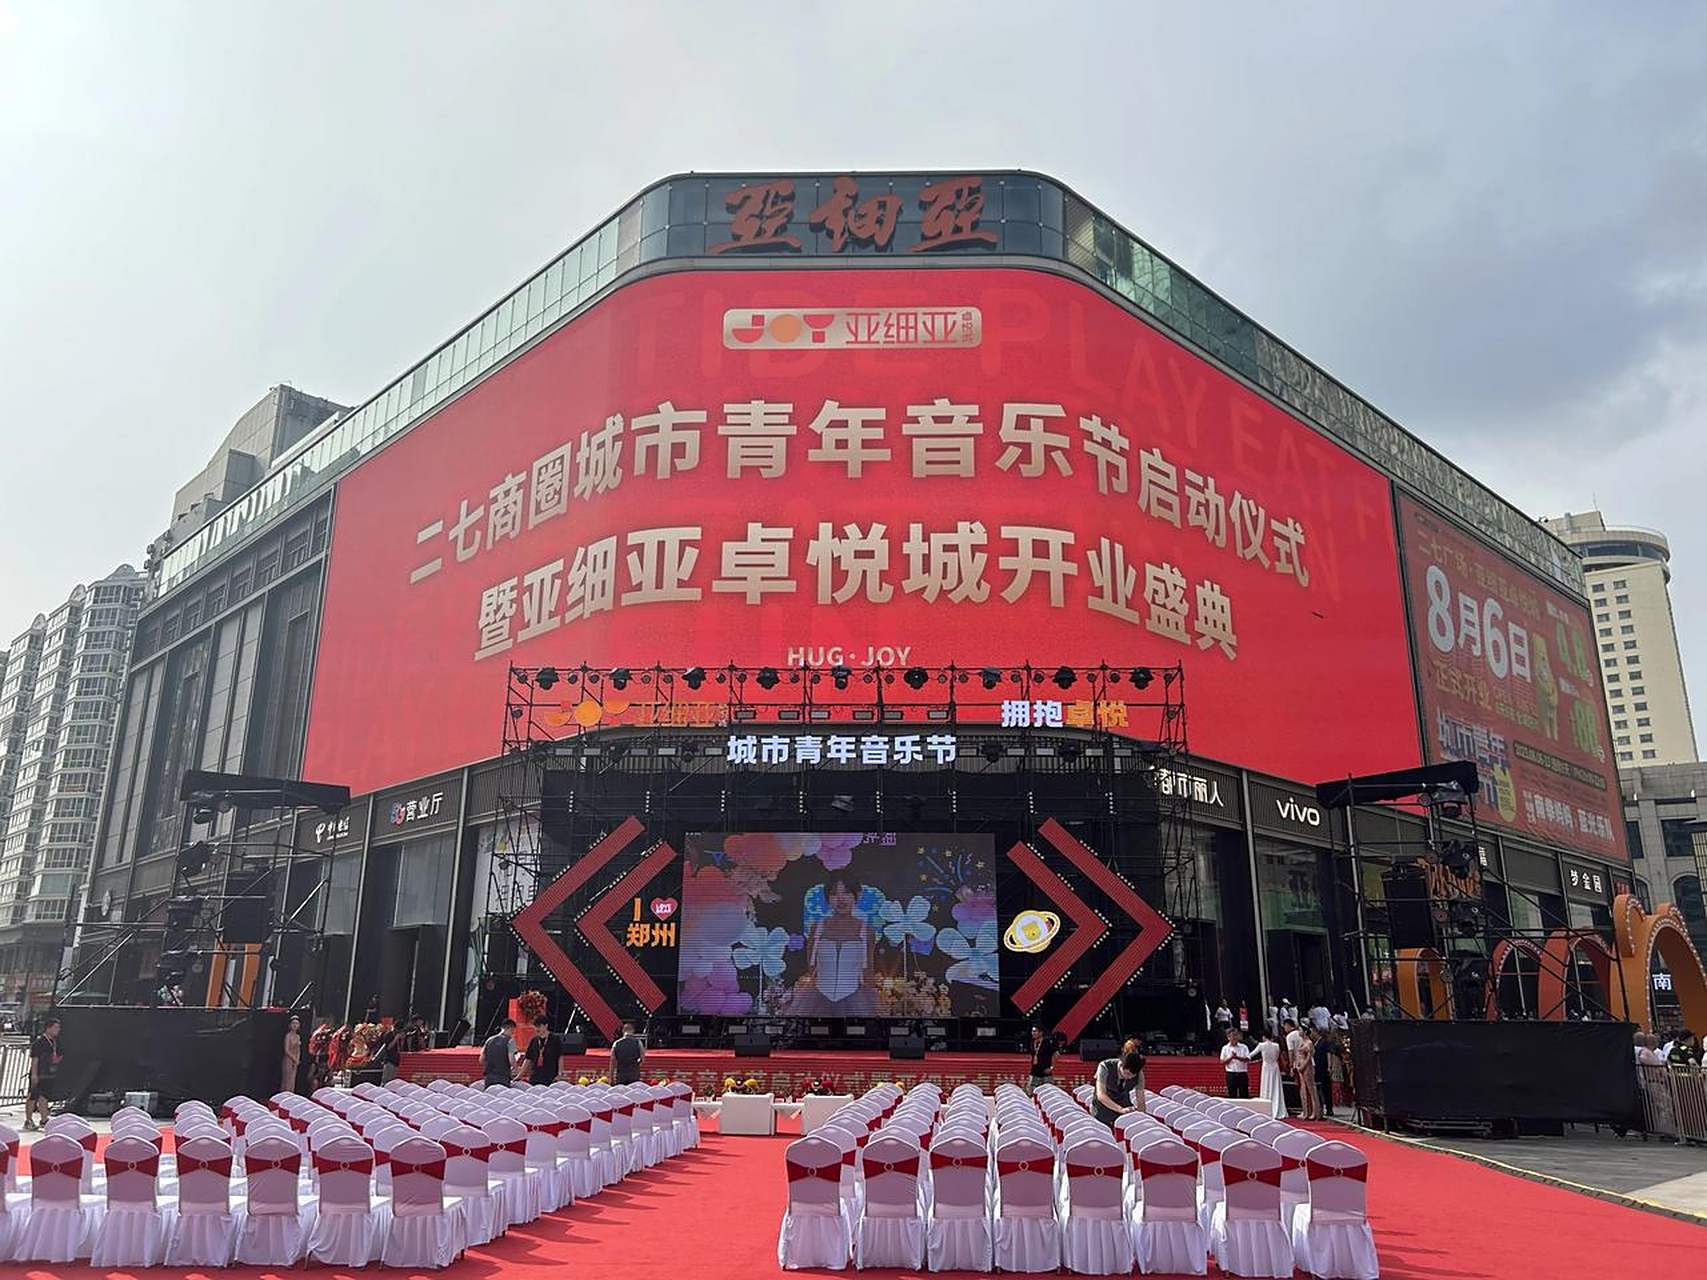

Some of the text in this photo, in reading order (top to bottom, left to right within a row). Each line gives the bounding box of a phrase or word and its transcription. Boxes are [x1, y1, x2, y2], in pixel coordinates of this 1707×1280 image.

[845, 311, 957, 345] 亚细亚
[410, 398, 1310, 588] 二七商圈城市青年音乐节启动仪式
[474, 520, 1238, 661] 暨亚细亚卓悦城开业盛典
[1426, 565, 1533, 683] 8月6日
[1001, 699, 1129, 729] 拥抱卓悦
[727, 735, 957, 765] 城市青年音乐节
[406, 792, 443, 822] 营业厅
[1276, 797, 1321, 827] vivo
[626, 922, 676, 947] 郑州
